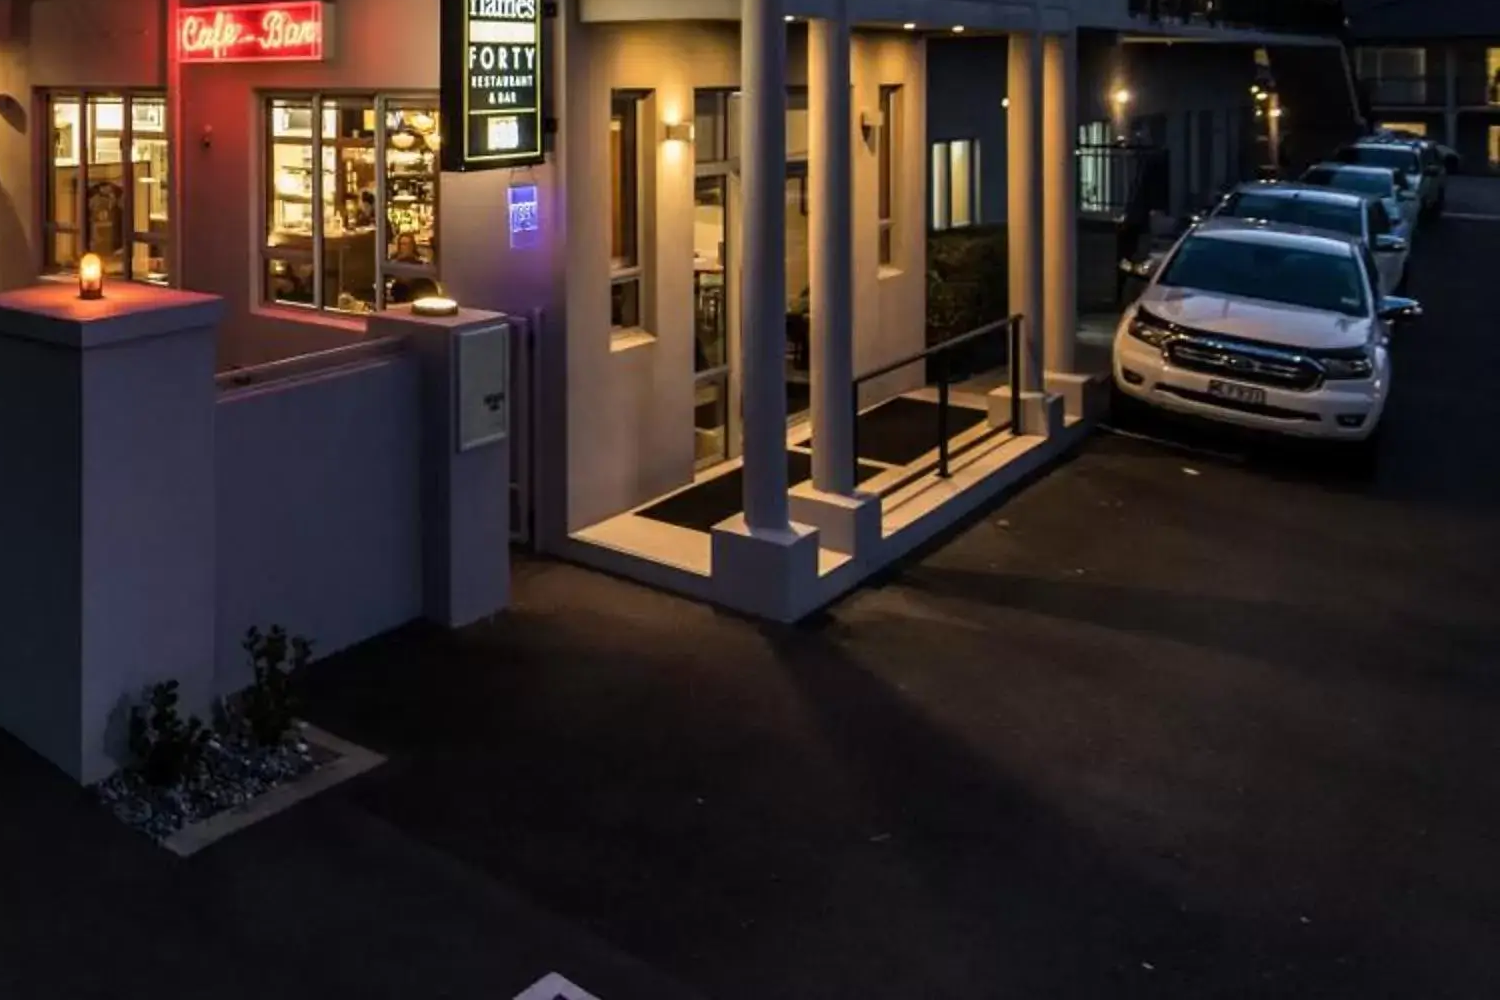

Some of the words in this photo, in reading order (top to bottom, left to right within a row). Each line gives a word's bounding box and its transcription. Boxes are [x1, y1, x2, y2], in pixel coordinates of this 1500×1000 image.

[469, 46, 535, 69] FORTY
[471, 75, 533, 88] RESTAURANT
[497, 91, 517, 104] BAR
